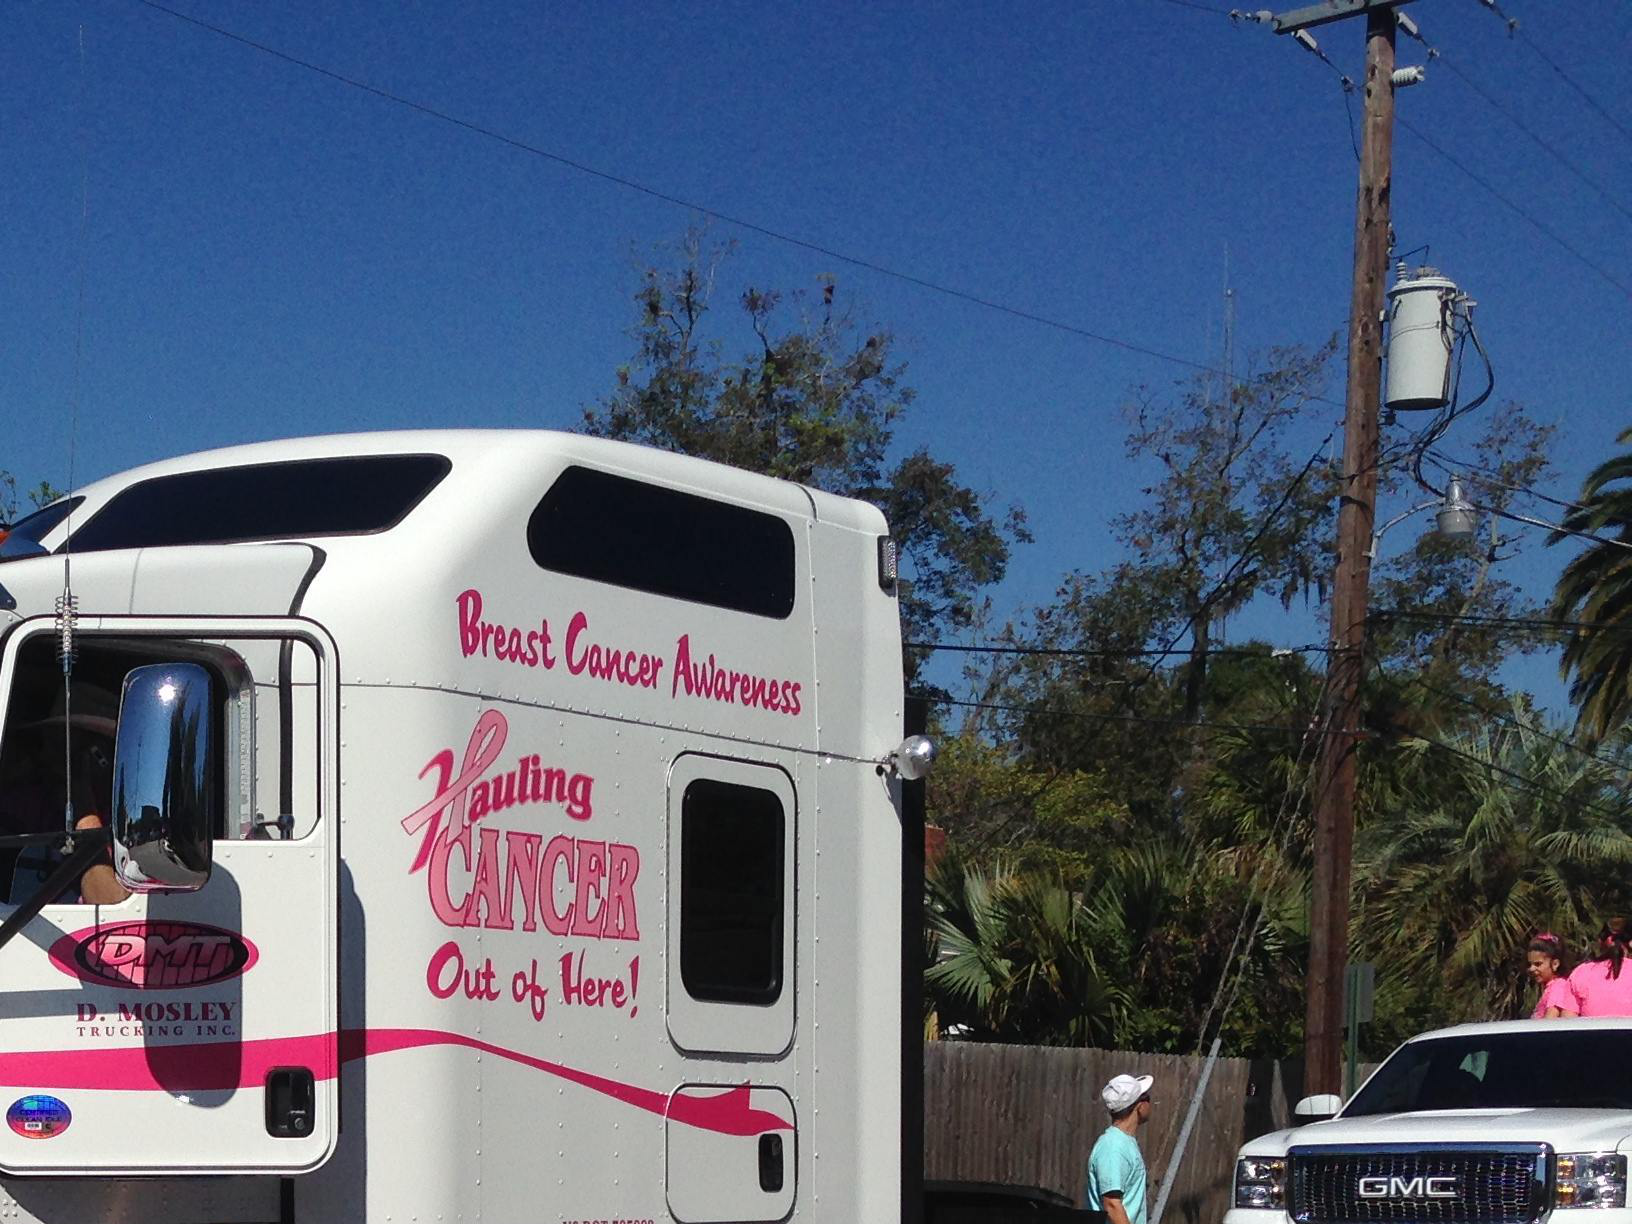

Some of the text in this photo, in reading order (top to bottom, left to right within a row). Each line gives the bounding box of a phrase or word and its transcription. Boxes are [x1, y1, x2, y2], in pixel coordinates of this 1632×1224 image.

[455, 588, 803, 716] Breast Cancer Awareness
[400, 708, 595, 875] Hauling
[427, 823, 640, 942] CANCER
[100, 934, 231, 968] DMT
[426, 941, 641, 1022] Out of Here!
[76, 1002, 237, 1023] D. MOSLEY
[77, 1025, 236, 1037] TRUCKING INC.
[1358, 1176, 1457, 1197] GMC
